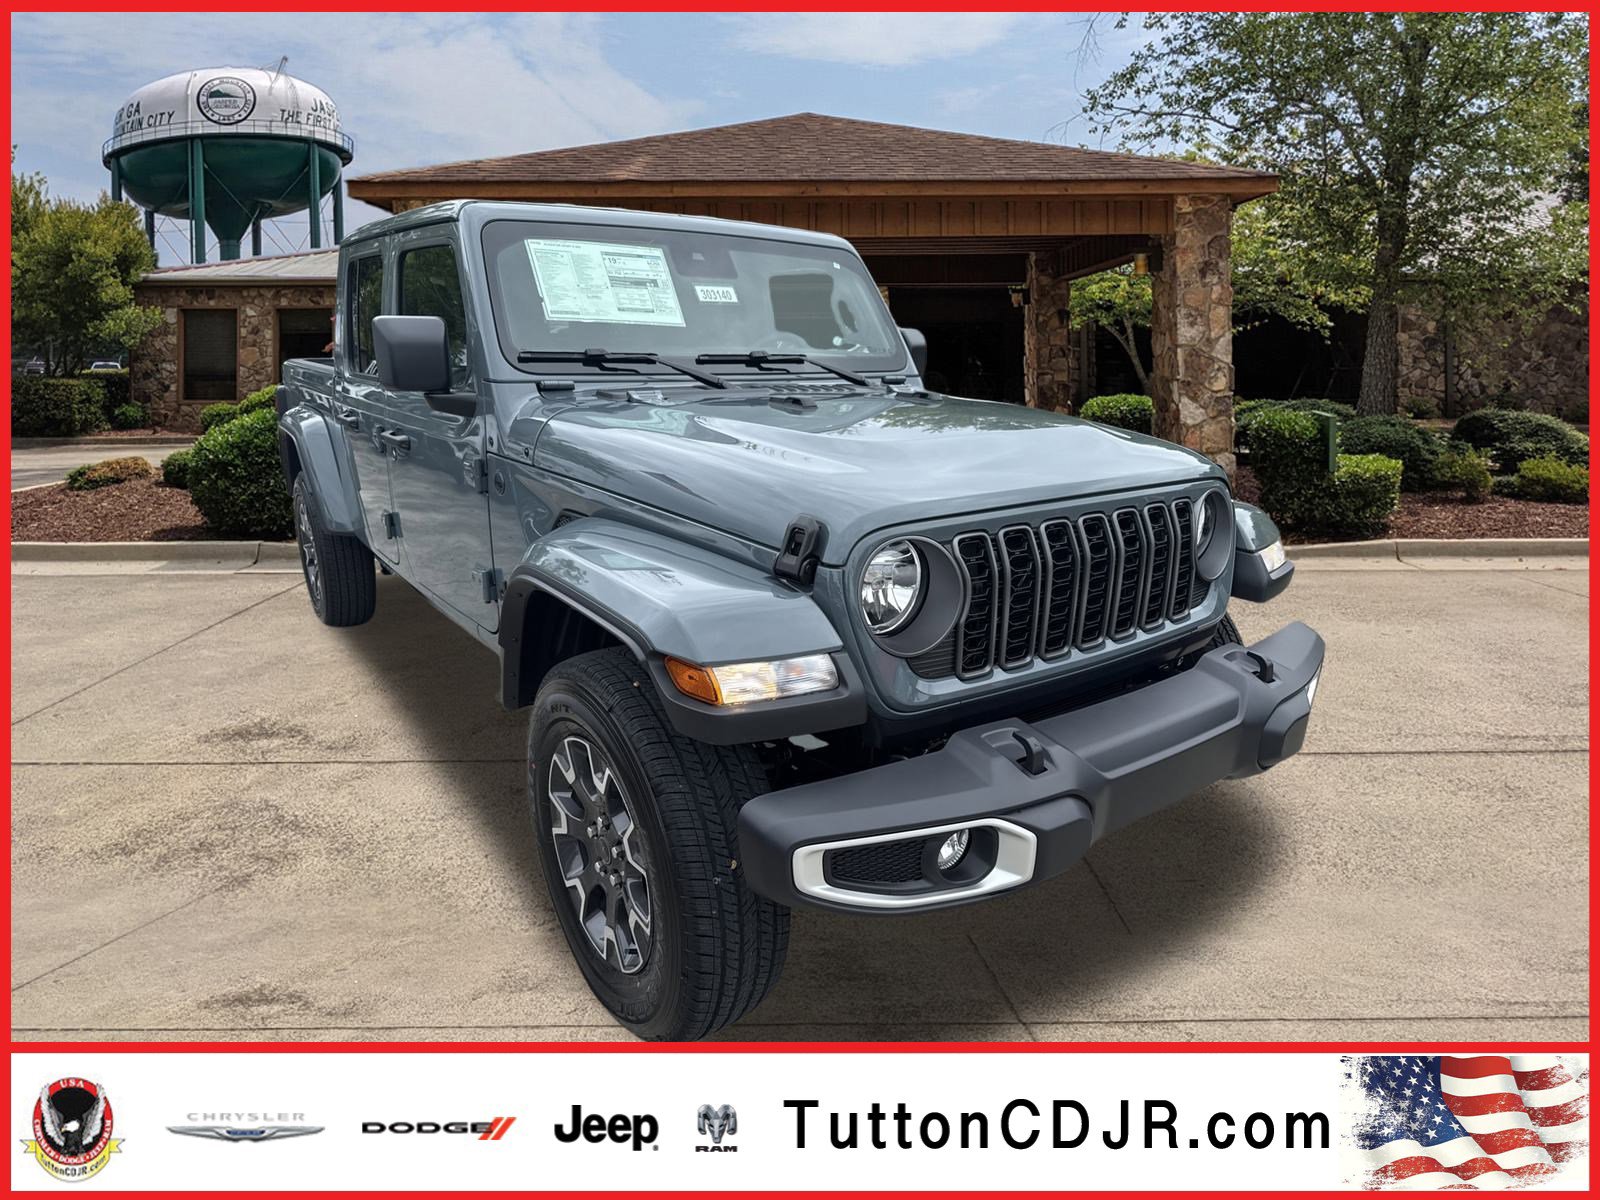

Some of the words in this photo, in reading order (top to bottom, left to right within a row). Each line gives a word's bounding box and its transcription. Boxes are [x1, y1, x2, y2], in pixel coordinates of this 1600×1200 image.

[127, 100, 141, 119] GA
[147, 110, 175, 127] CITY
[280, 109, 302, 124] THE
[306, 112, 332, 131] FIRST
[700, 289, 732, 301] 303140
